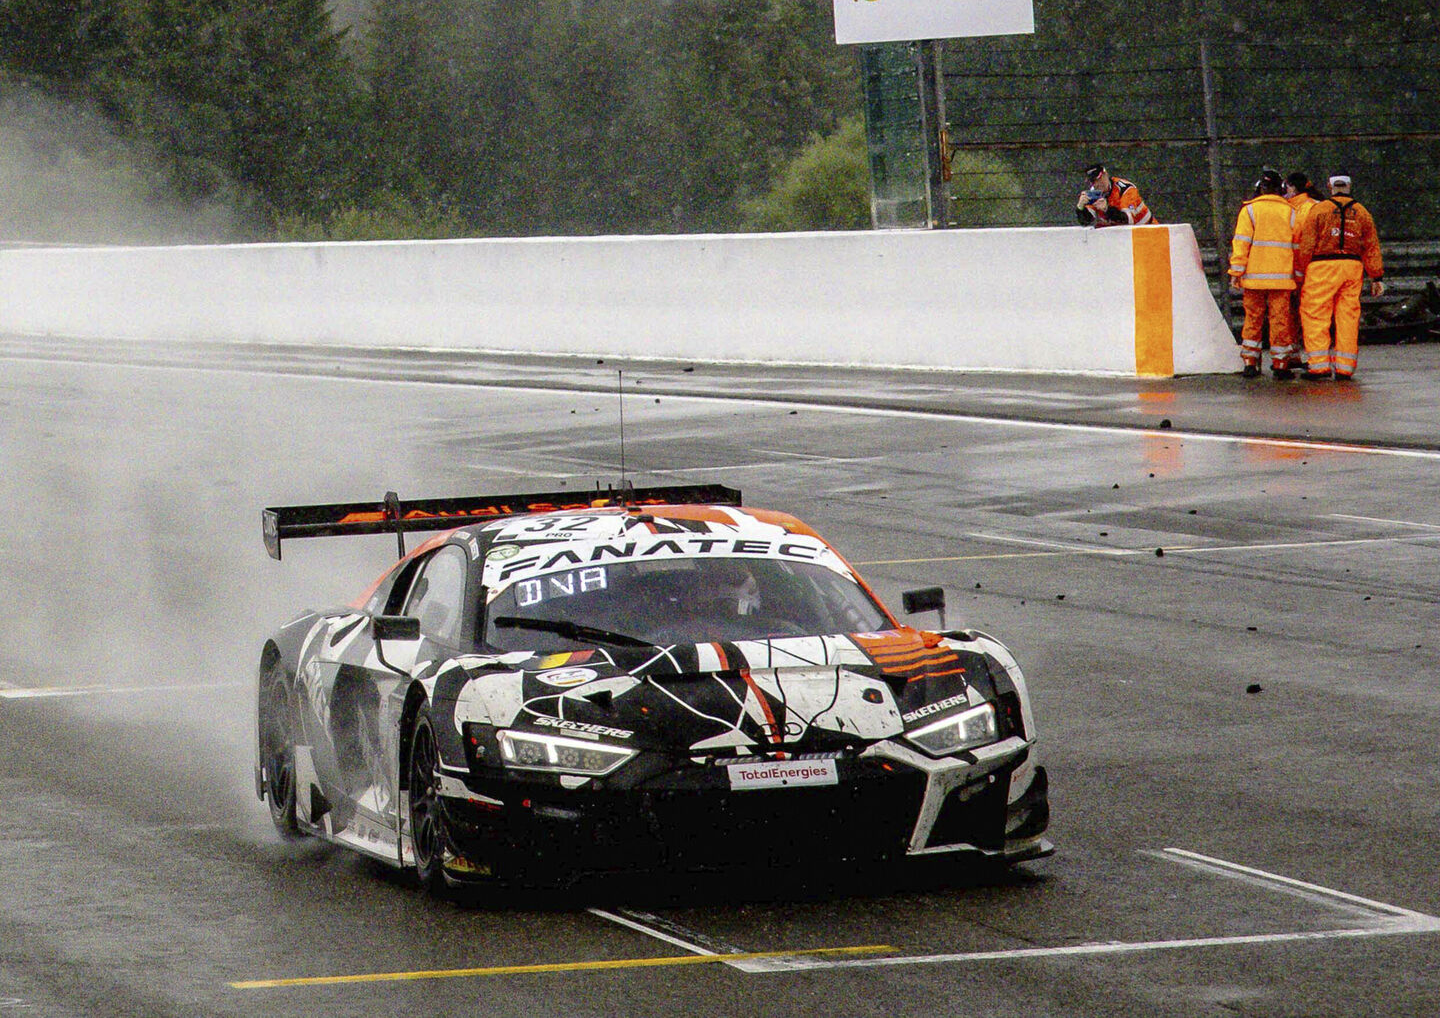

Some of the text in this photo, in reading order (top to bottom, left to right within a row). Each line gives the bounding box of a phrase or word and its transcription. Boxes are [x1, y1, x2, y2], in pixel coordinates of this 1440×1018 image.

[523, 516, 600, 533] 32
[498, 539, 818, 582] FANATEC
[902, 693, 968, 723] SKECHERS
[533, 717, 634, 739] SKECHERS
[739, 766, 828, 781] TotalEnergies
